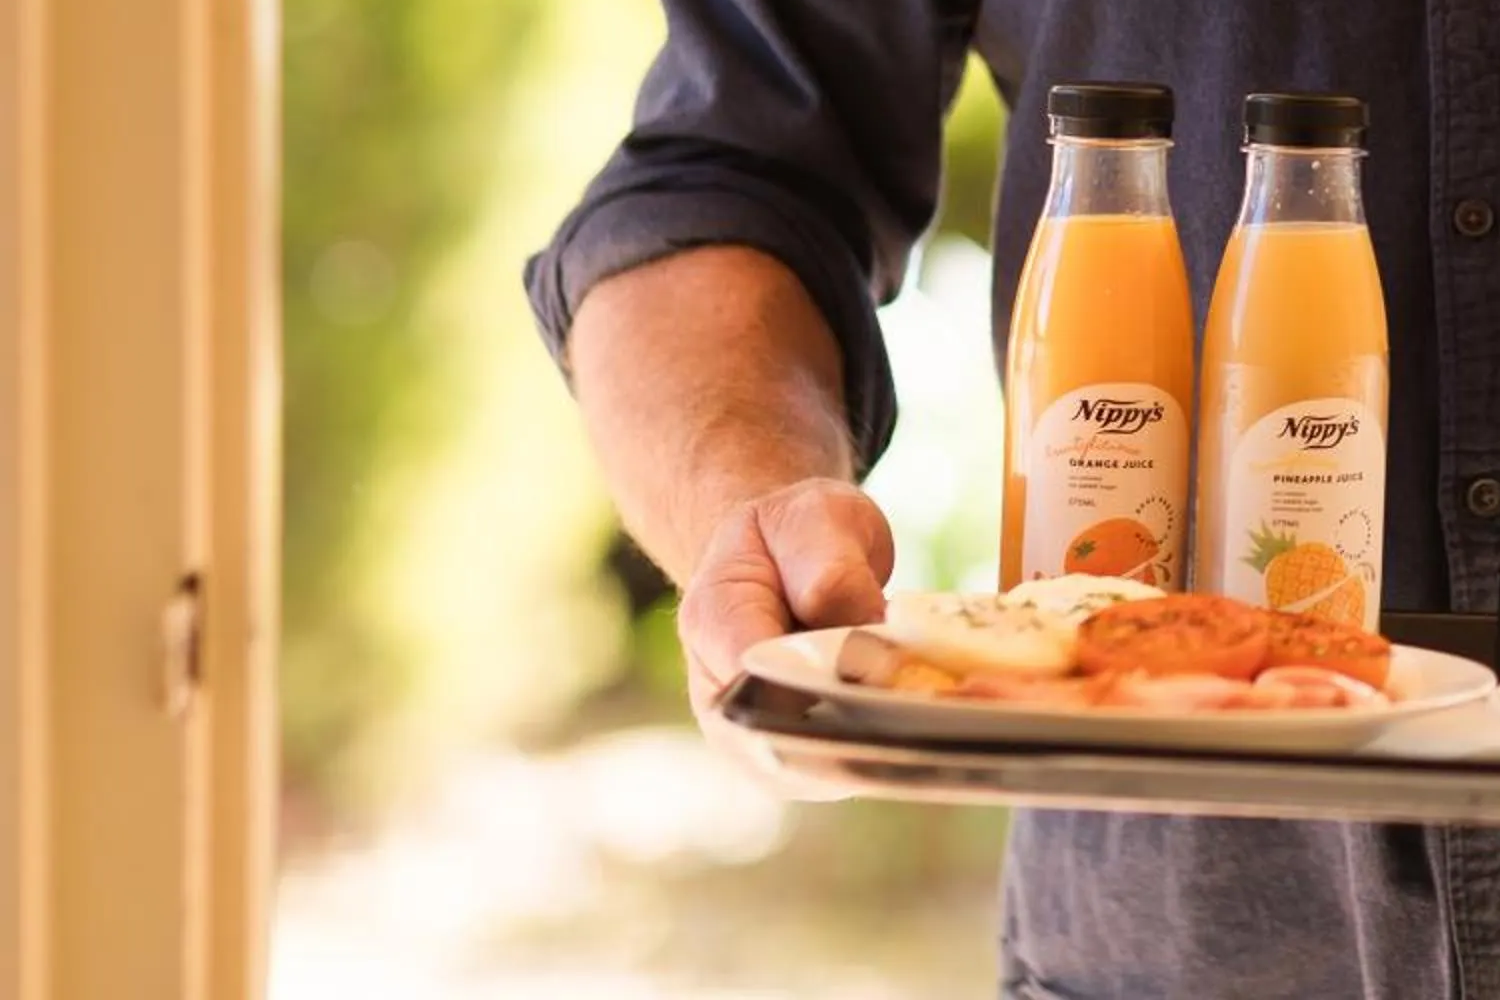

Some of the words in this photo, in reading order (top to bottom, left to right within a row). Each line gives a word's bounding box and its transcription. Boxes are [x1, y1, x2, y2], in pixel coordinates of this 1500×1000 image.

[1072, 399, 1164, 434] Nippy's
[1279, 415, 1359, 450] Nippy's
[1069, 458, 1118, 468] ORANGE
[1122, 459, 1154, 468] JUICE
[1273, 474, 1333, 484] PINEAPPLE
[1336, 472, 1363, 483] JUICE
